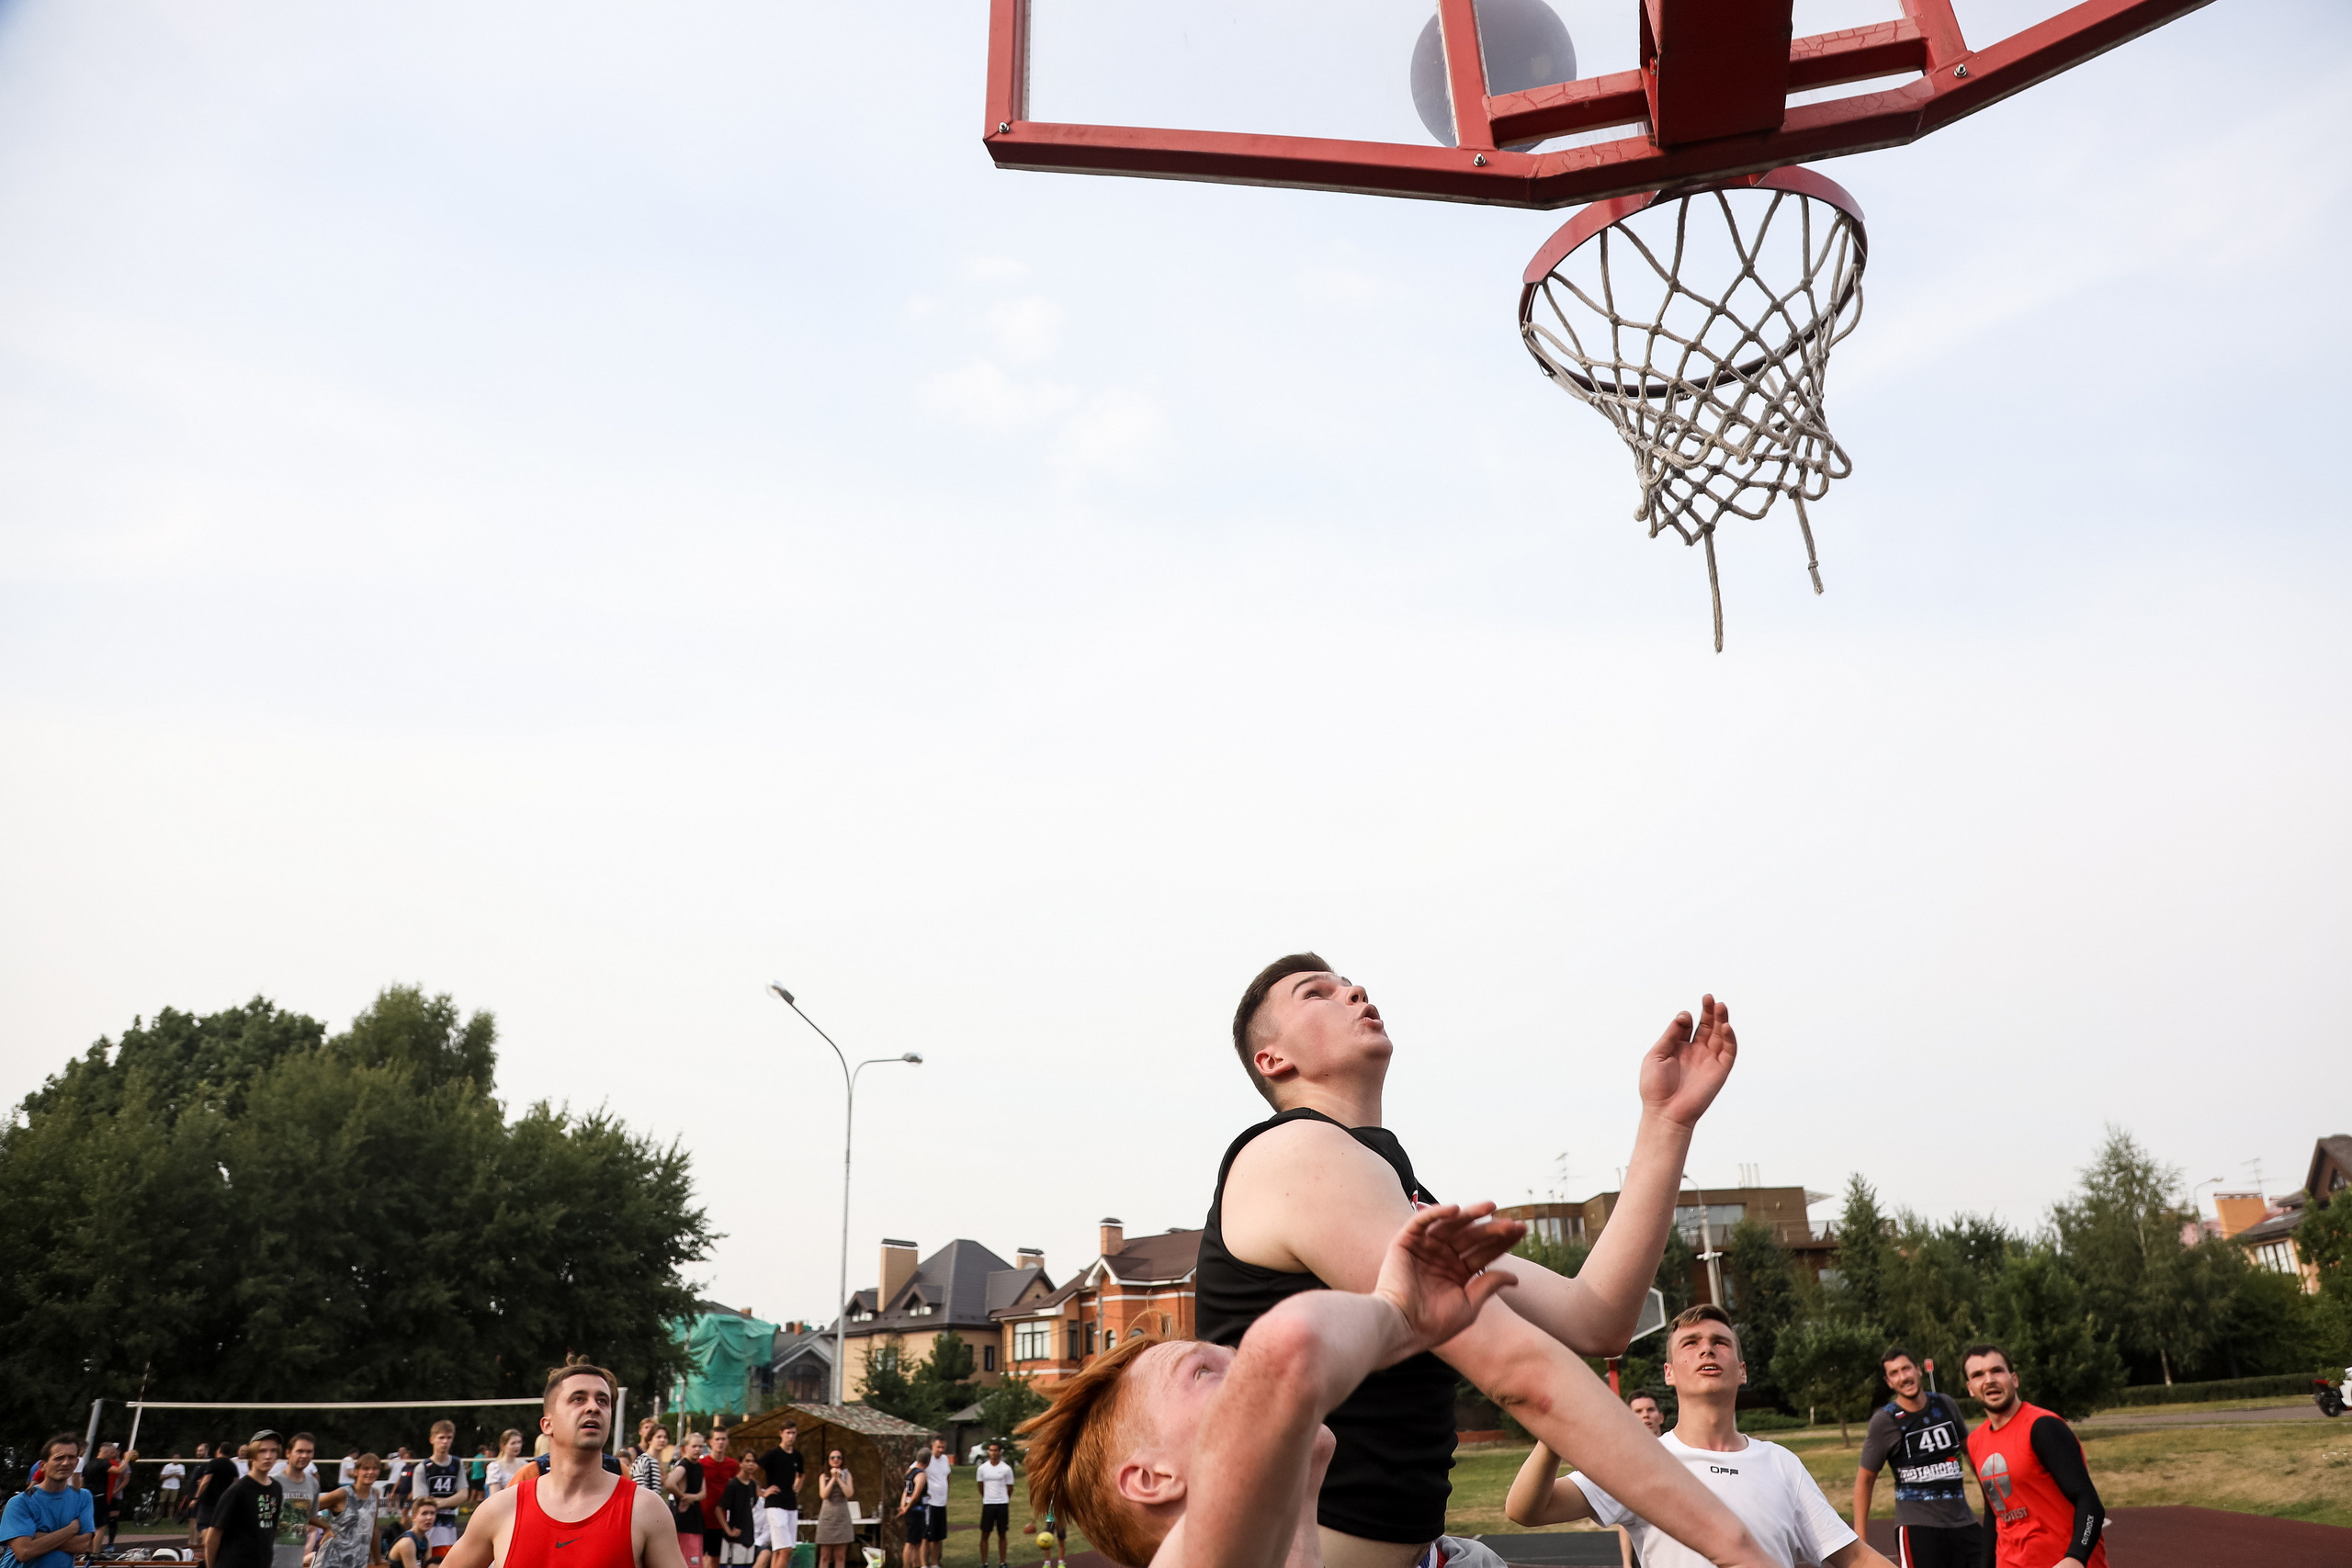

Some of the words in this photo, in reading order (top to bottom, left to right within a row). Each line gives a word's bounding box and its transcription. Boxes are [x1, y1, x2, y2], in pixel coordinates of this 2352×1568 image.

[1919, 1427, 1951, 1452] 40
[1710, 1466, 1739, 1476] OFF
[434, 1477, 452, 1492] 44
[2081, 1514, 2095, 1545] OUTSHOCK
